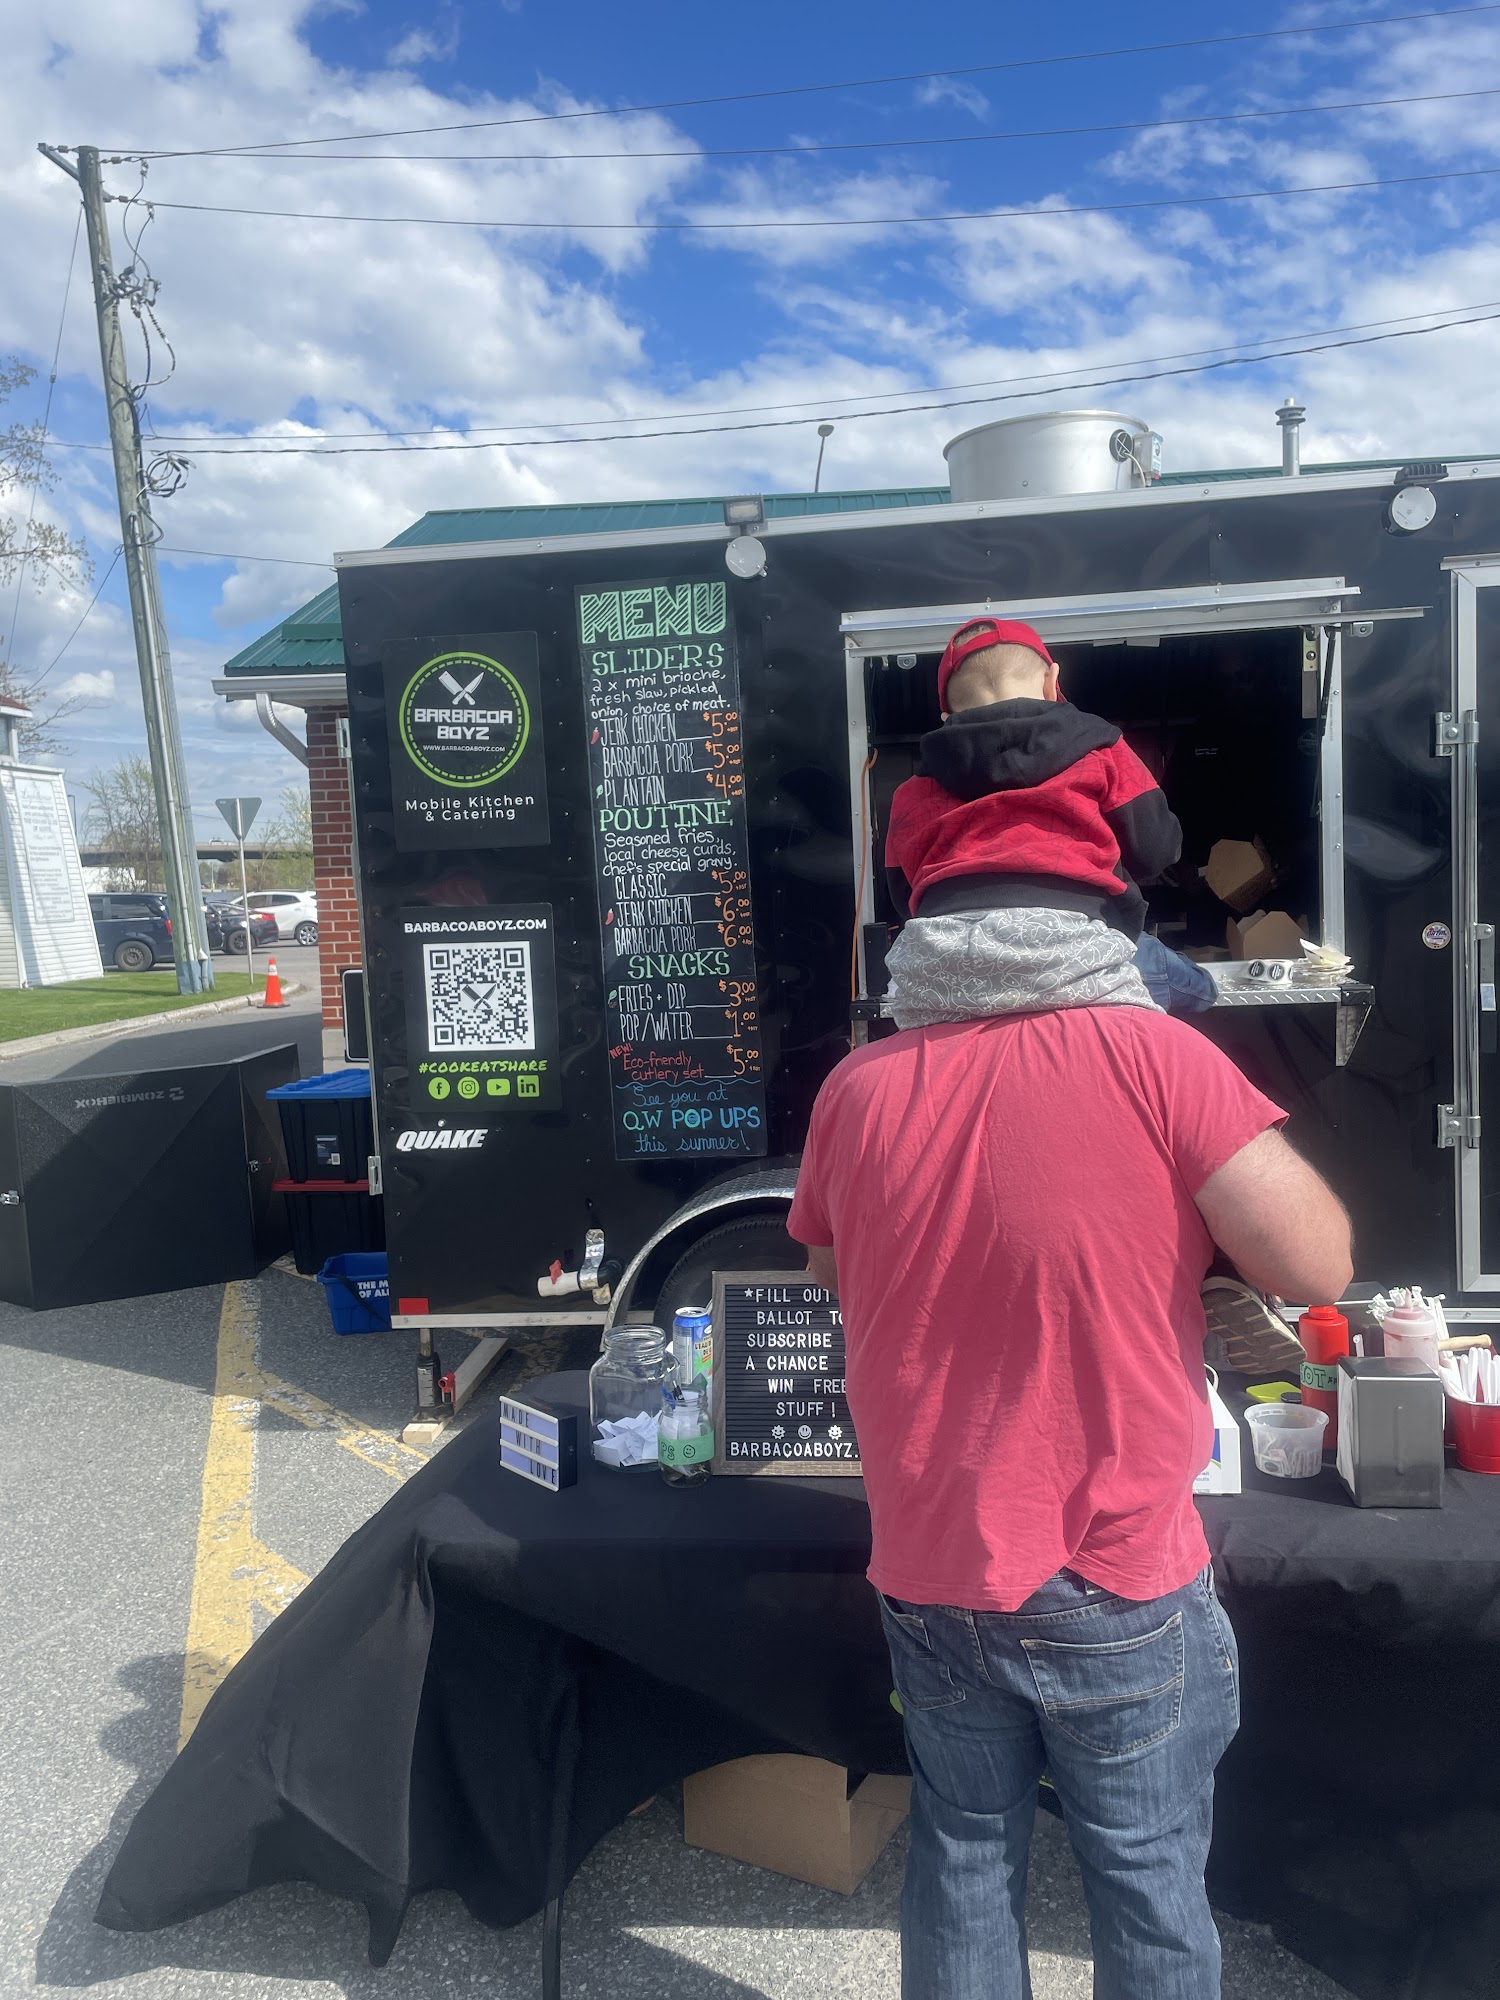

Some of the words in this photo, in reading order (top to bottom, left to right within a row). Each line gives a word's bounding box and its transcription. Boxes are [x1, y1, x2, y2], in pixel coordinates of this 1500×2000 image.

[580, 581, 727, 644] MENU
[592, 642, 725, 676] SLIDERS
[592, 679, 602, 692] 2
[608, 681, 617, 692] x
[626, 673, 657, 689] mini
[662, 669, 727, 685] brioche,
[590, 691, 632, 707] fresh
[635, 687, 668, 700] slaw,
[670, 681, 719, 698] pickled
[414, 708, 513, 724] BARBACOA
[591, 706, 629, 720] onion,
[632, 702, 671, 716] choice
[675, 700, 690, 711] of
[692, 694, 731, 711] meat.
[436, 725, 490, 740] BOYZ
[600, 716, 630, 746] JERK
[632, 713, 678, 744] CHICKEN
[422, 744, 506, 752] WWW.BARBACOABOYZ.COM
[603, 745, 661, 778] BARBACOA
[665, 742, 695, 773] PORK
[405, 797, 461, 811] Mobile
[468, 794, 534, 808] Kitchen
[603, 775, 666, 808] PLANTAIN
[425, 811, 435, 822] &
[442, 807, 516, 822] Catering
[599, 800, 734, 832] POUTINE
[604, 829, 671, 848] Seasoned
[678, 828, 720, 844] fries,
[604, 845, 635, 862] local
[641, 844, 689, 860] cheese
[693, 839, 737, 857] curds,
[602, 861, 643, 877] chef's
[647, 856, 692, 875] special
[697, 857, 738, 873] gravy.
[614, 873, 667, 900] CLASSIC
[616, 900, 646, 928] JERK
[648, 896, 694, 926] CHICKEN
[404, 918, 547, 934] BARBACOABOYZ.COM
[614, 926, 668, 956] BARBACOA
[671, 925, 697, 953] PORK
[627, 950, 731, 980] SNACKS
[618, 983, 654, 1013] FRIES
[667, 982, 688, 1010] DIP
[620, 1012, 695, 1043] POP/WATER
[609, 1043, 633, 1060] NEW!
[623, 1050, 692, 1072] Eco-friendly
[418, 1060, 548, 1074] #COOKEATSHARE
[631, 1067, 679, 1085] cutlery
[682, 1063, 705, 1079] set
[632, 1085, 665, 1108] See
[669, 1091, 701, 1108] you
[707, 1083, 729, 1101] at
[623, 1109, 663, 1131] QW
[671, 1107, 713, 1130] POP
[720, 1106, 761, 1129] UPS
[395, 1129, 489, 1151] QUAKE
[634, 1133, 667, 1153] this
[676, 1130, 751, 1151] summer!
[357, 1281, 377, 1290] THE
[358, 1290, 372, 1299] OF
[756, 1310, 812, 1325] BALLOT
[746, 1333, 832, 1348] SUBSCRIBE
[745, 1355, 756, 1371] A
[766, 1355, 828, 1371] CHANCE
[767, 1378, 794, 1394] WIN
[502, 1403, 529, 1428] MADE
[515, 1430, 541, 1455] WITH
[530, 1459, 556, 1485] LOVE
